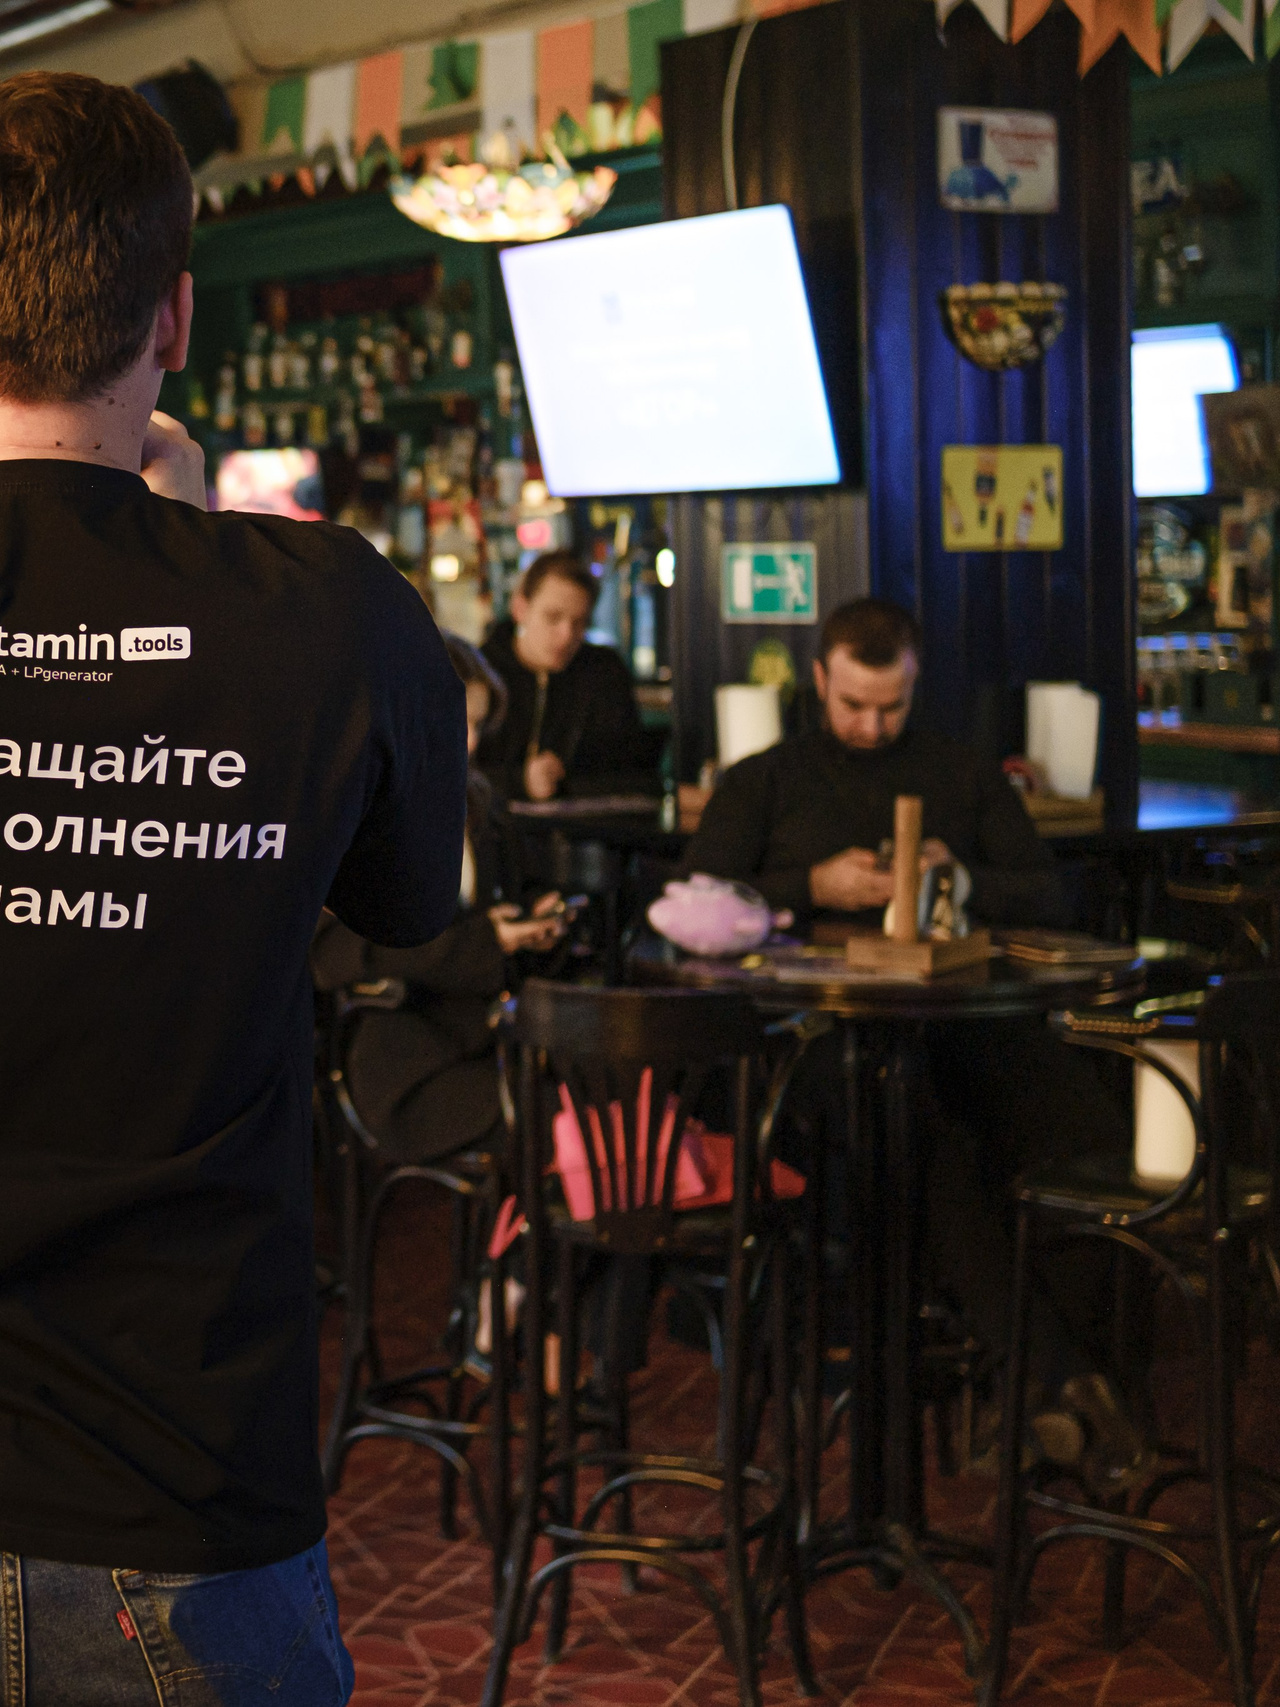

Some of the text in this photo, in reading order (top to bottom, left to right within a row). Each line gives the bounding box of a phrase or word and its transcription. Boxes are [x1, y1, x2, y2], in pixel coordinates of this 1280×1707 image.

[128, 633, 184, 653] .tools
[11, 667, 20, 677] +
[24, 666, 114, 682] LPgenerator
